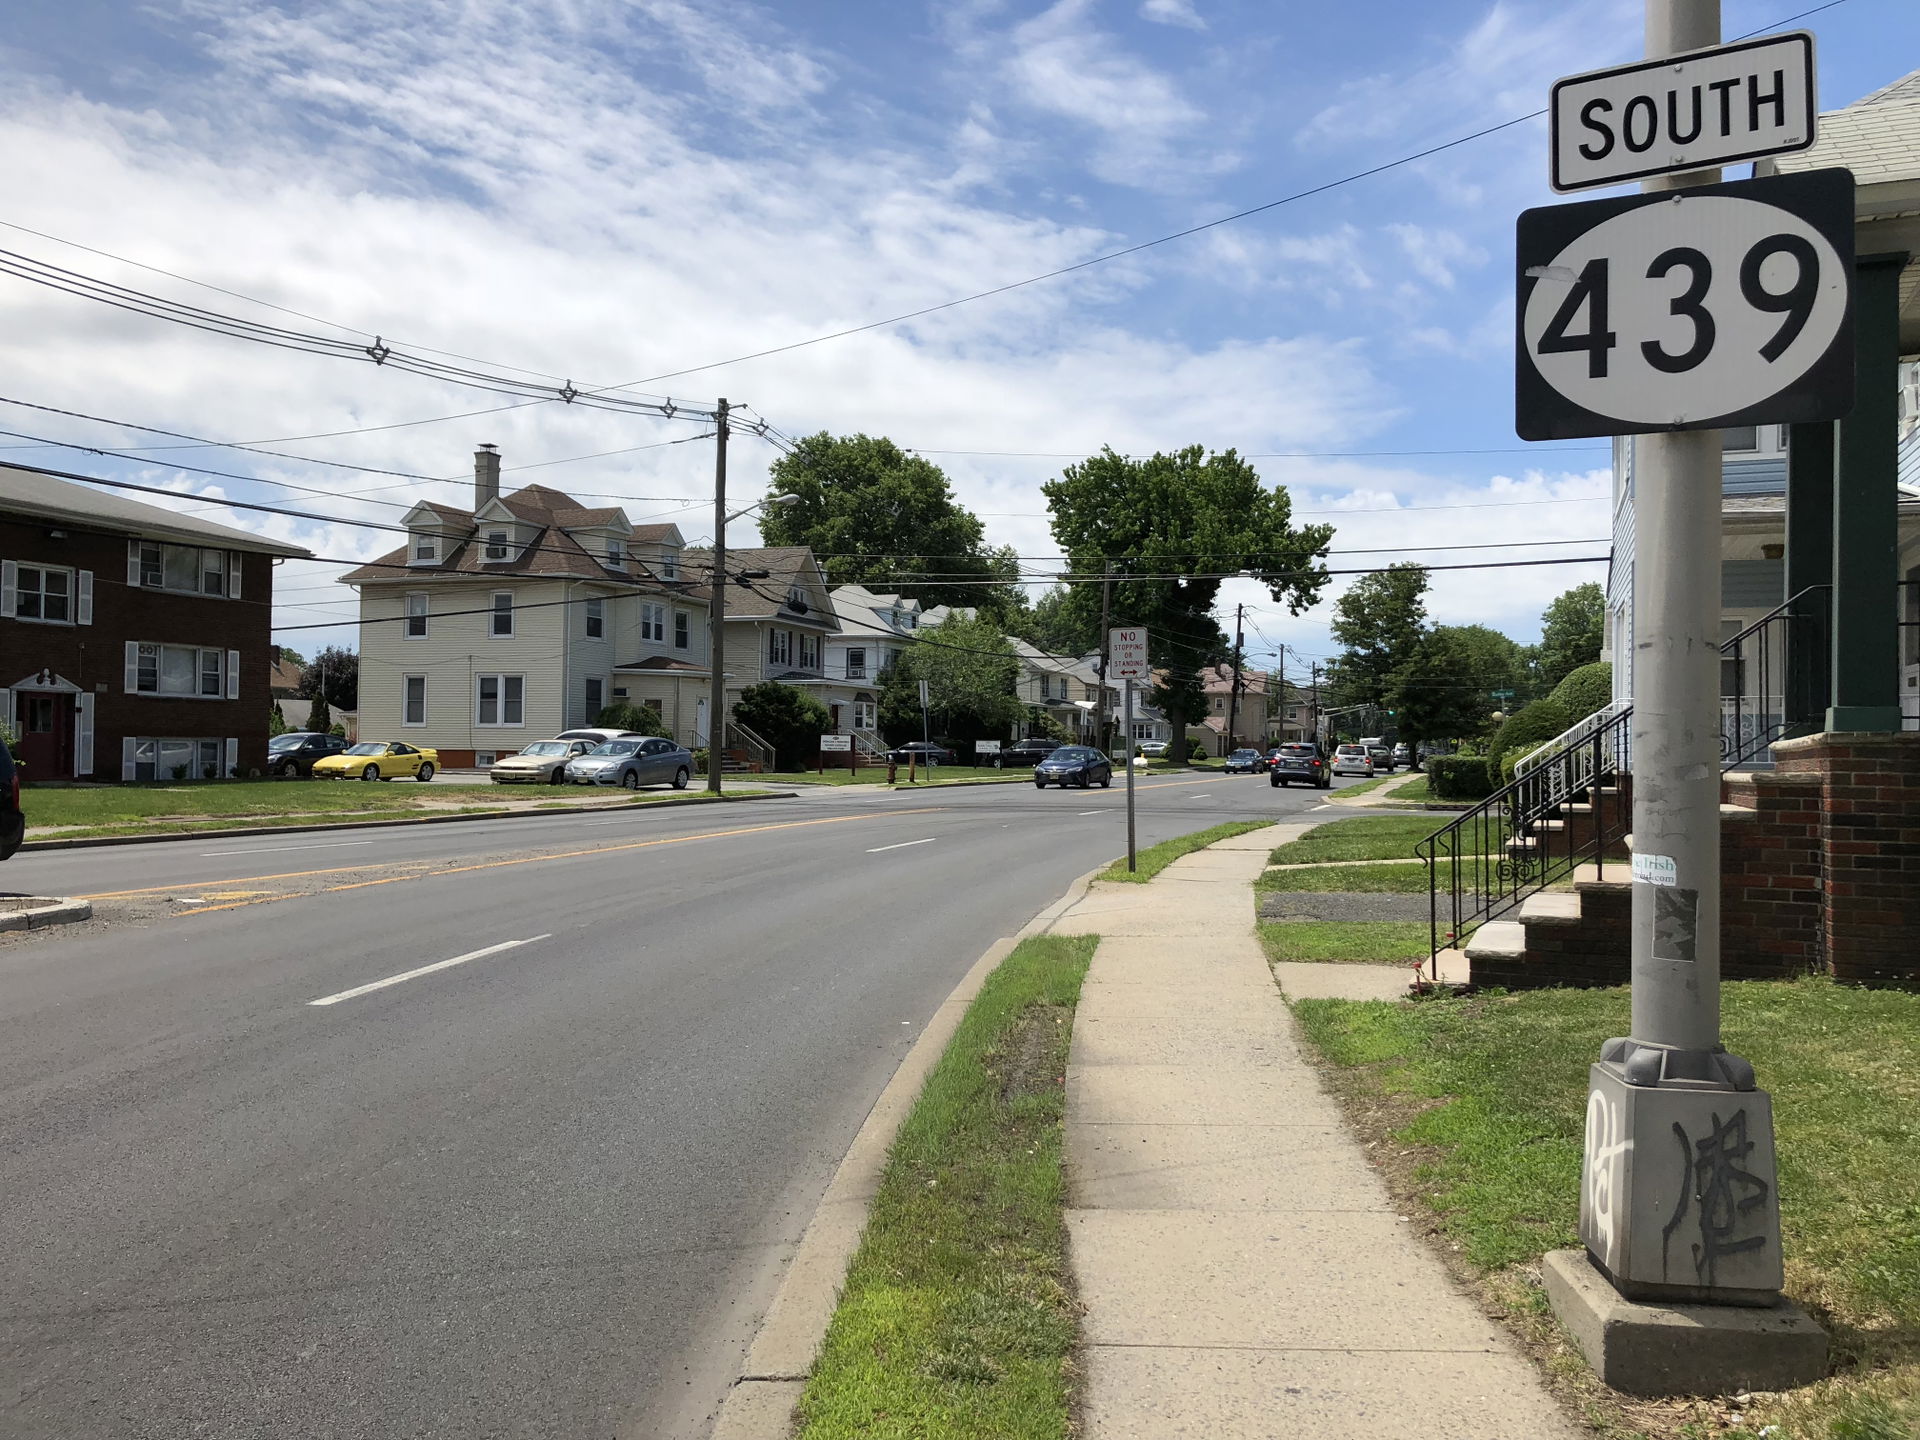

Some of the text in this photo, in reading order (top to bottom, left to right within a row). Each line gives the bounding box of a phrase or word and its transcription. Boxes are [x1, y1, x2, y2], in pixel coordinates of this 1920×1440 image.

[1578, 69, 1785, 161] SOUTH
[1537, 233, 1820, 379] 439
[1120, 631, 1136, 642] NO
[1644, 856, 1674, 871] Irish
